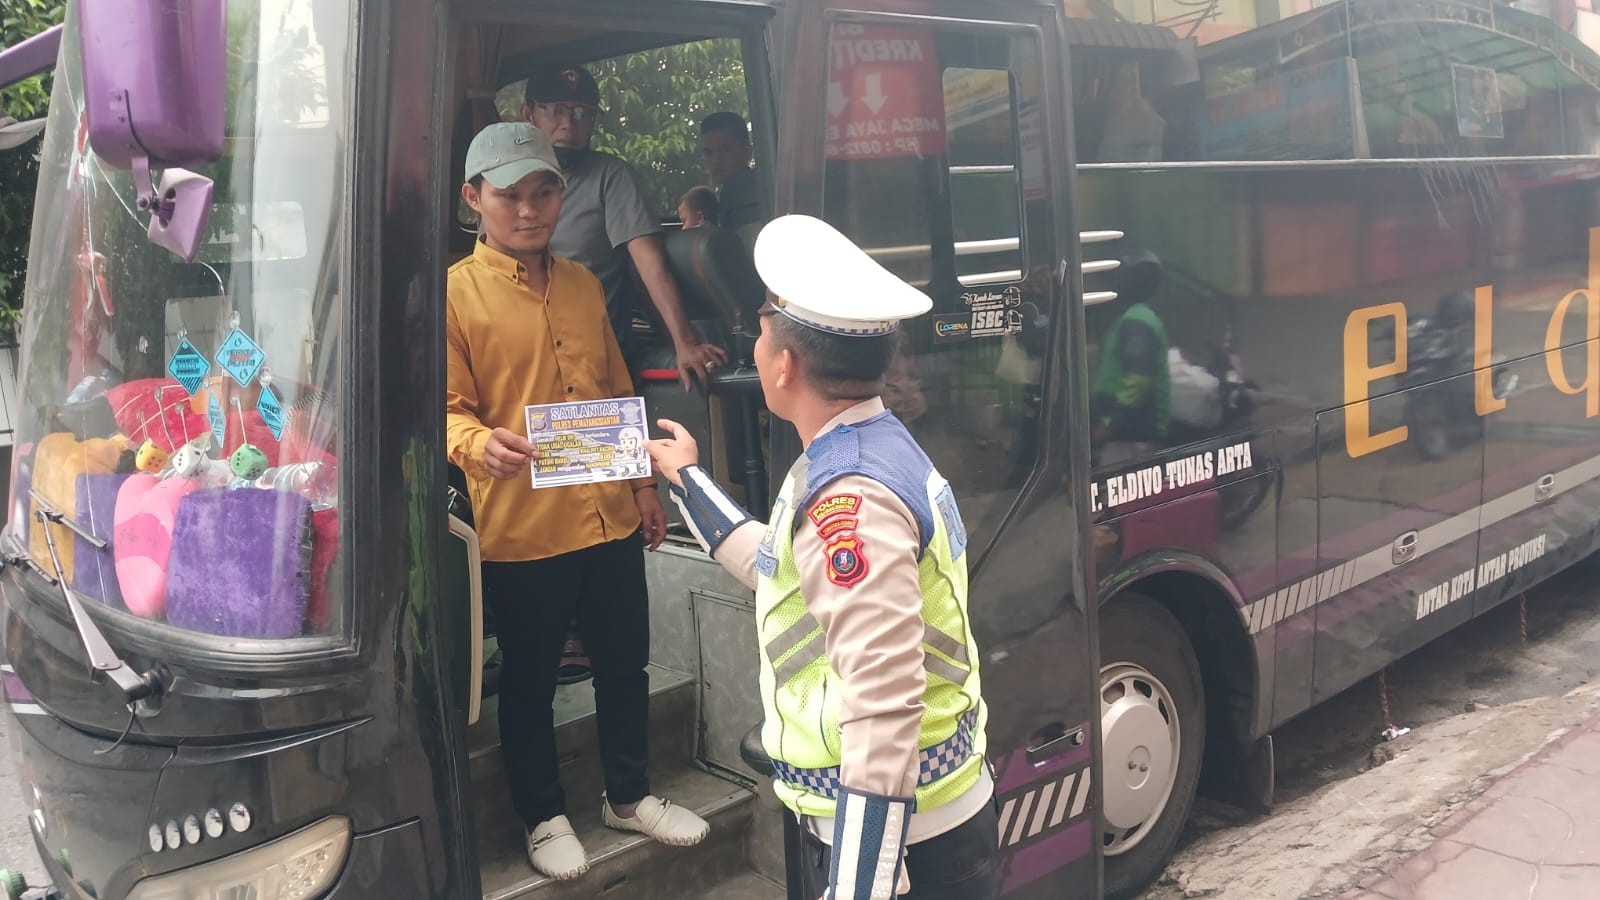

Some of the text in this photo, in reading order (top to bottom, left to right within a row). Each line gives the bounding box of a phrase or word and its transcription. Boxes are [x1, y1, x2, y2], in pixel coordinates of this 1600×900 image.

[971, 310, 1004, 330] ISBC
[551, 402, 619, 420] SATLANTAS
[551, 419, 572, 430] POLRES
[1106, 465, 1163, 508] ELDIVO
[1165, 451, 1214, 490] TUNAS
[1217, 441, 1252, 476] ARTA
[812, 496, 856, 517] POLRES
[1416, 533, 1546, 620] ANTAR KOTA ANTAR PROVINSI
